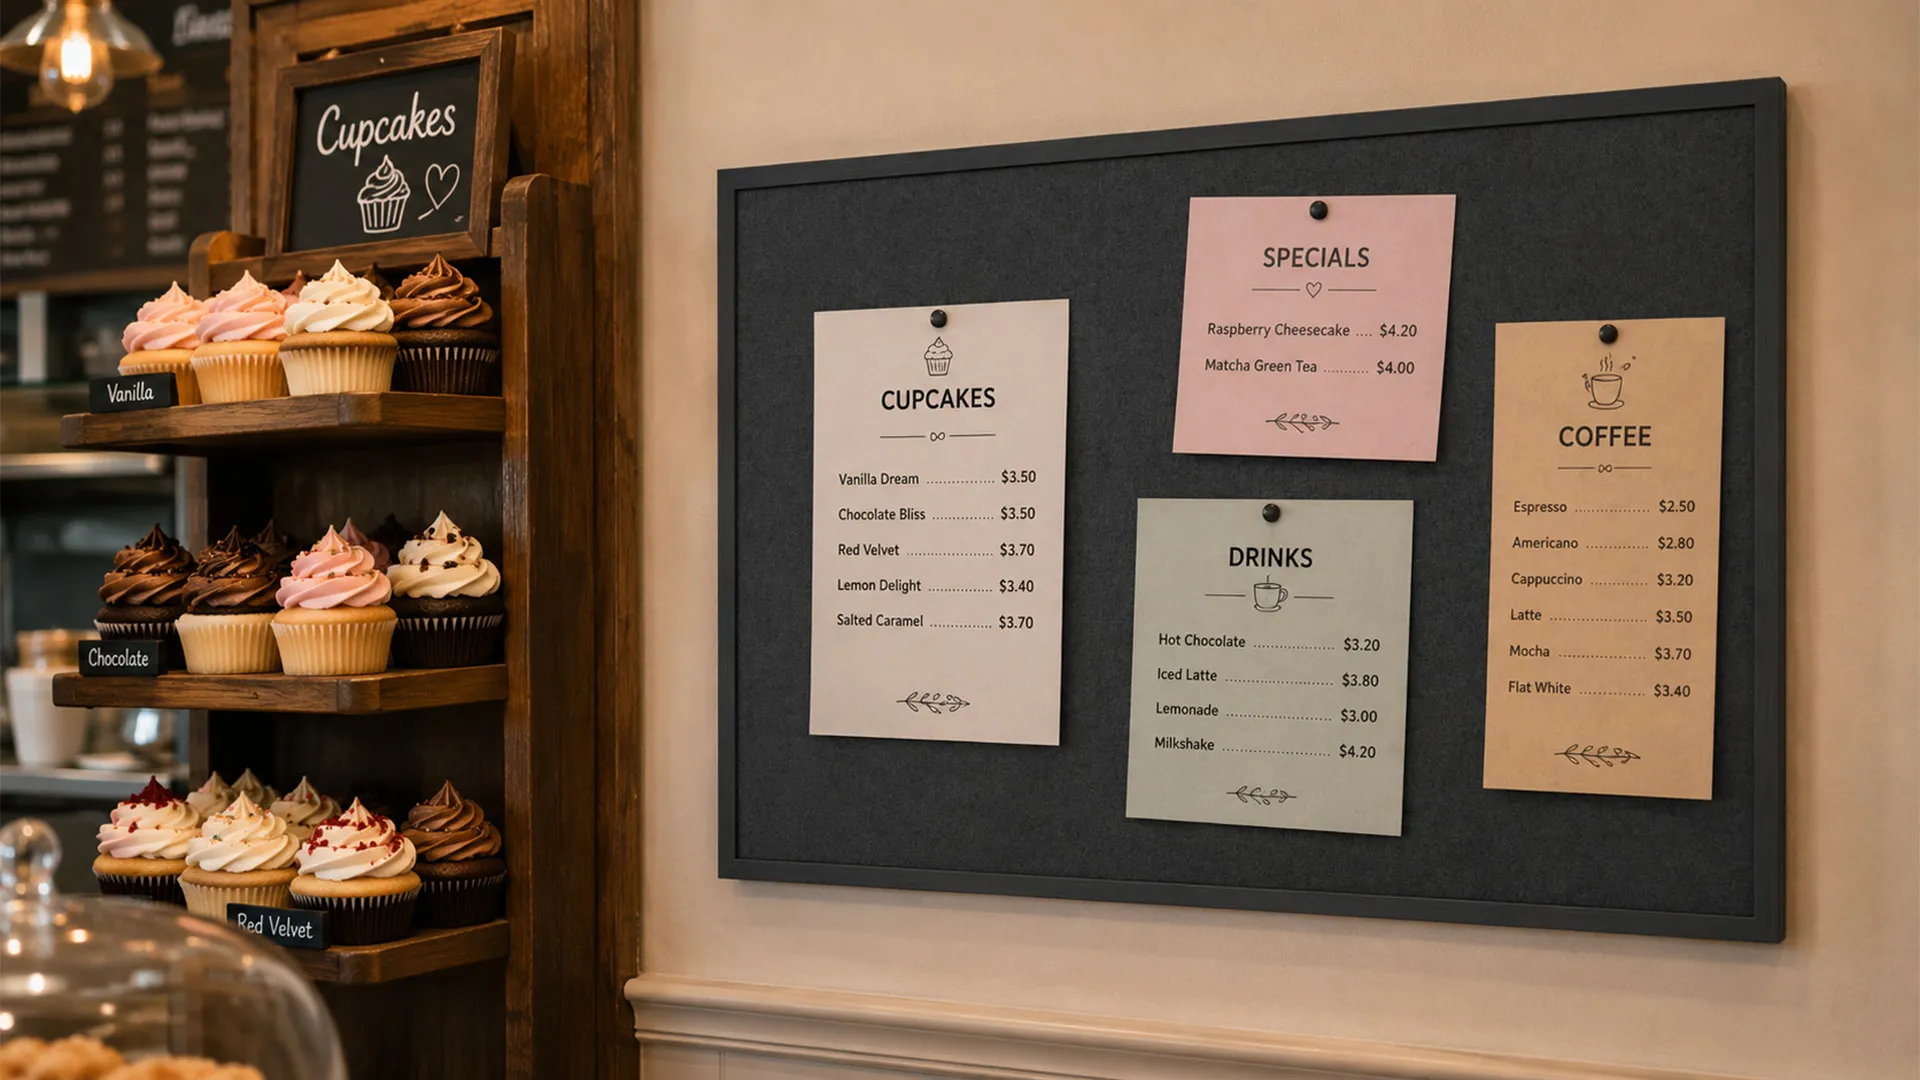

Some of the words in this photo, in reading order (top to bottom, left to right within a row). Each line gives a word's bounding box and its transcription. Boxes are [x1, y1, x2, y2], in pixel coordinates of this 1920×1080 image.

[316, 91, 456, 167] Cupcakes
[1262, 246, 1370, 268] SPECIALS
[1207, 322, 1272, 339] Raspberry
[1274, 322, 1351, 337] Cheesecake
[1379, 322, 1418, 339] $4.20
[1204, 358, 1251, 372] Matcha
[1253, 358, 1292, 373] Green
[1295, 359, 1318, 373] Tea
[1376, 359, 1415, 376] $4.00
[106, 380, 155, 404] Vanilla
[881, 387, 996, 411] CUPCAKES
[1558, 425, 1652, 448] COFFEE
[838, 472, 878, 486] Vanilla
[880, 472, 920, 485] Dream
[1001, 469, 1037, 485] $3.50
[838, 507, 897, 521] Chocolate
[899, 507, 926, 521] Bliss
[1000, 505, 1036, 521] $3.50
[1513, 500, 1568, 516] Espresso
[1658, 499, 1696, 514] $2.50
[837, 543, 861, 557] Red
[862, 543, 900, 557] Velvet
[999, 542, 1035, 558] $3.70
[1511, 536, 1579, 550] Americano
[1657, 535, 1695, 551] $2.80
[1229, 546, 1313, 569] DRINKS
[837, 578, 877, 591] Lemon
[879, 578, 922, 595] Delight
[999, 578, 1035, 594] $3.40
[1511, 571, 1583, 588] Cappuccino
[1656, 572, 1694, 588] $3.20
[836, 613, 873, 627] Salted
[875, 613, 924, 628] Caramel
[998, 614, 1034, 630] $3.70
[1510, 608, 1543, 621] Latte
[1655, 609, 1693, 624] $3.50
[1158, 632, 1182, 646] Hot
[1184, 633, 1246, 648] Chocolate
[1343, 636, 1381, 652] $3.20
[88, 646, 149, 667] Chocolate
[1509, 644, 1551, 658] Mocha
[1654, 646, 1692, 662] $3.70
[1157, 667, 1183, 681] Iced
[1185, 668, 1218, 682] Latte
[1341, 672, 1380, 688] $3.80
[1508, 680, 1532, 694] Flat
[1534, 681, 1572, 695] White
[1653, 683, 1691, 699] $3.40
[1155, 701, 1219, 717] Lemonade
[1340, 708, 1378, 724] $3.00
[1154, 736, 1215, 751] Milkshake
[1339, 743, 1377, 759] $4.20
[237, 912, 264, 935] Red
[268, 915, 314, 940] Velvet
